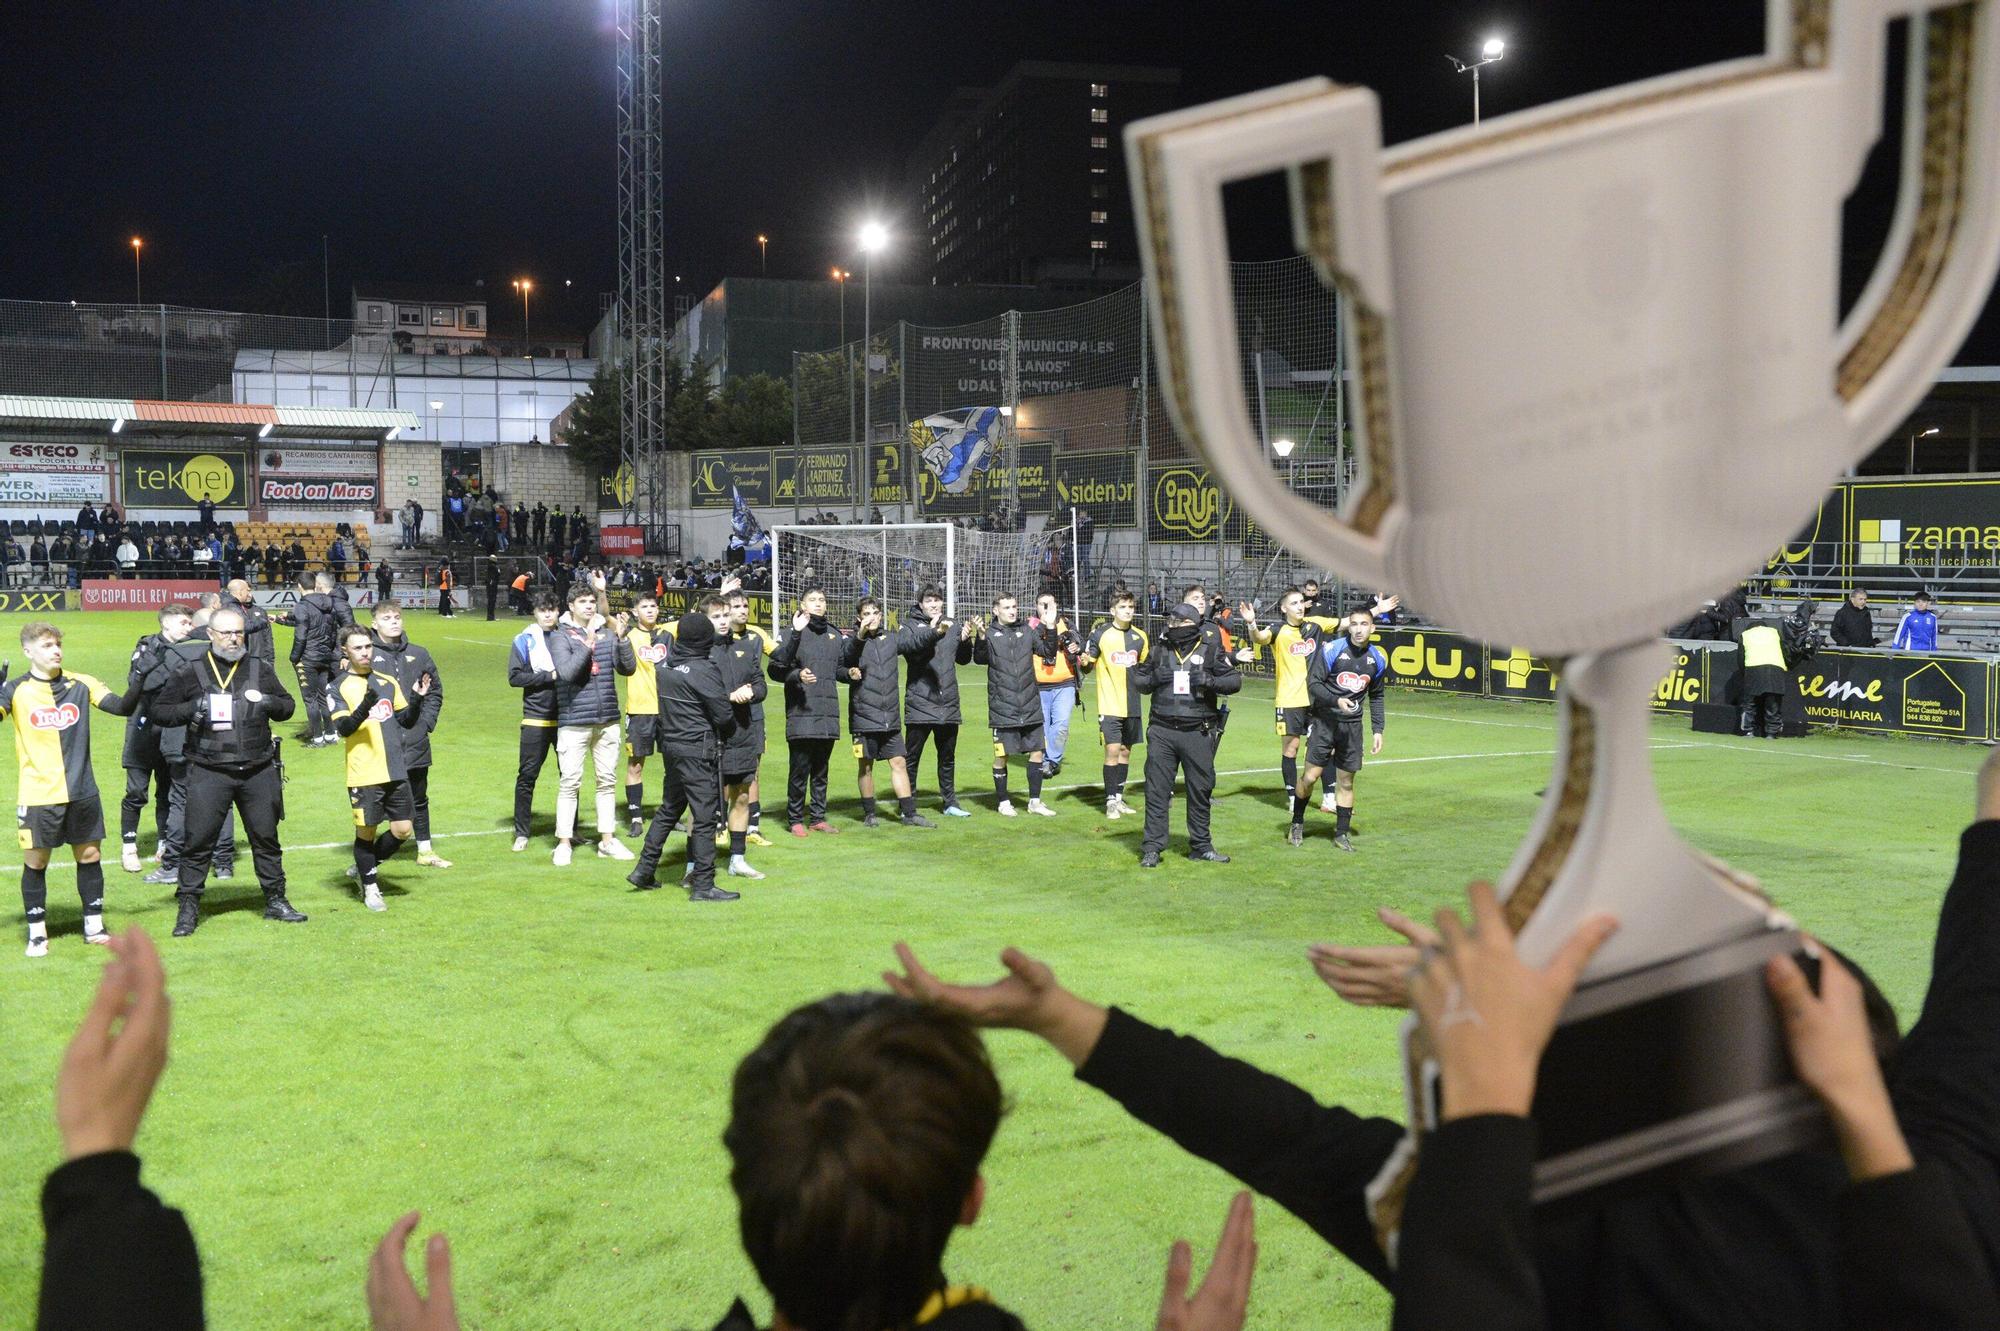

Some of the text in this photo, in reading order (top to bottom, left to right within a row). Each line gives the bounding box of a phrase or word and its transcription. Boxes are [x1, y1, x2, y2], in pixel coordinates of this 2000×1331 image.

[922, 336, 1115, 353] FRONTONES MUNICIPALES
[958, 379, 997, 392] UDAL
[9, 444, 79, 458] ESTECO
[285, 451, 377, 460] RECAMBIOS CANTABRICOS
[807, 455, 847, 468] FERNANDO
[135, 462, 228, 490] teknei
[263, 481, 375, 499] Foot on Mars
[1904, 526, 2000, 549] zama
[1904, 557, 1992, 566] constucciones
[15, 593, 61, 611] XX
[101, 589, 127, 603] COPA
[130, 589, 147, 603] DEL
[150, 590, 168, 603] REY
[1396, 677, 1418, 686] SANTA
[1805, 705, 1883, 722] NMOBILIARIA
